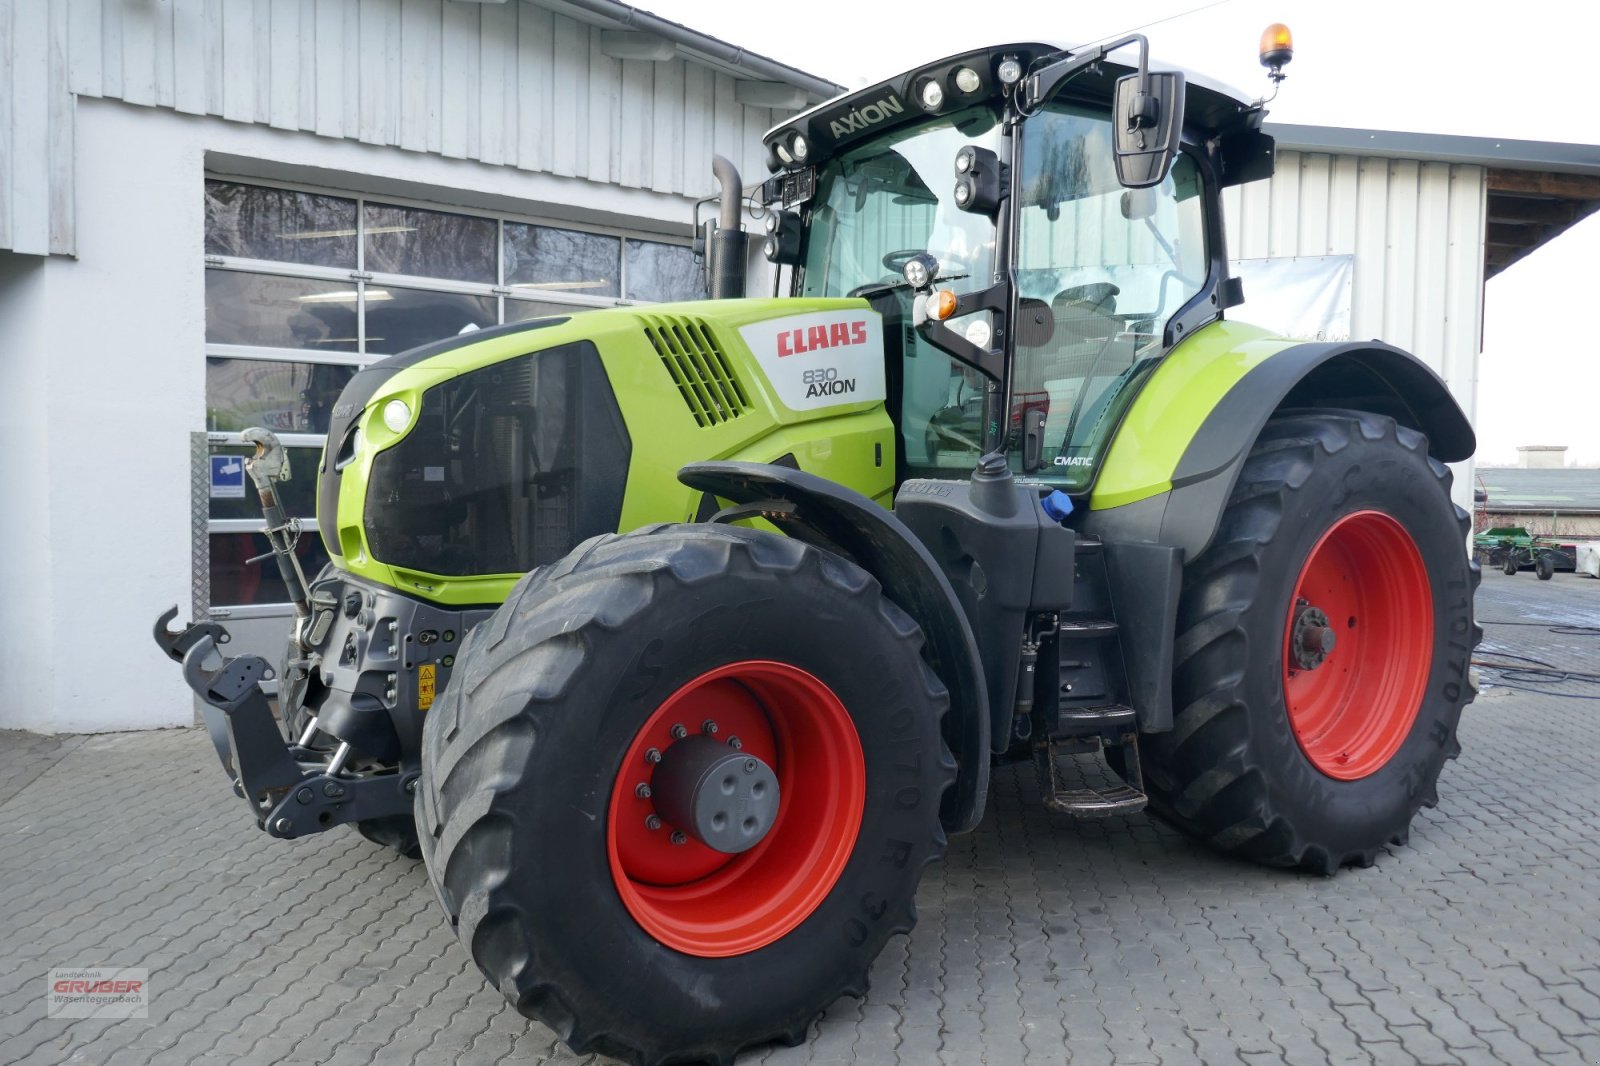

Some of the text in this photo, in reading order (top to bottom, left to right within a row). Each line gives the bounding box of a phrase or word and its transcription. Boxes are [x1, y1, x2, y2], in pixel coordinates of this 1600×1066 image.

[829, 95, 904, 139] AXION
[777, 321, 867, 358] CLAAS
[802, 367, 837, 384] 830
[805, 378, 856, 399] AXION
[1053, 456, 1094, 467] CMATIC
